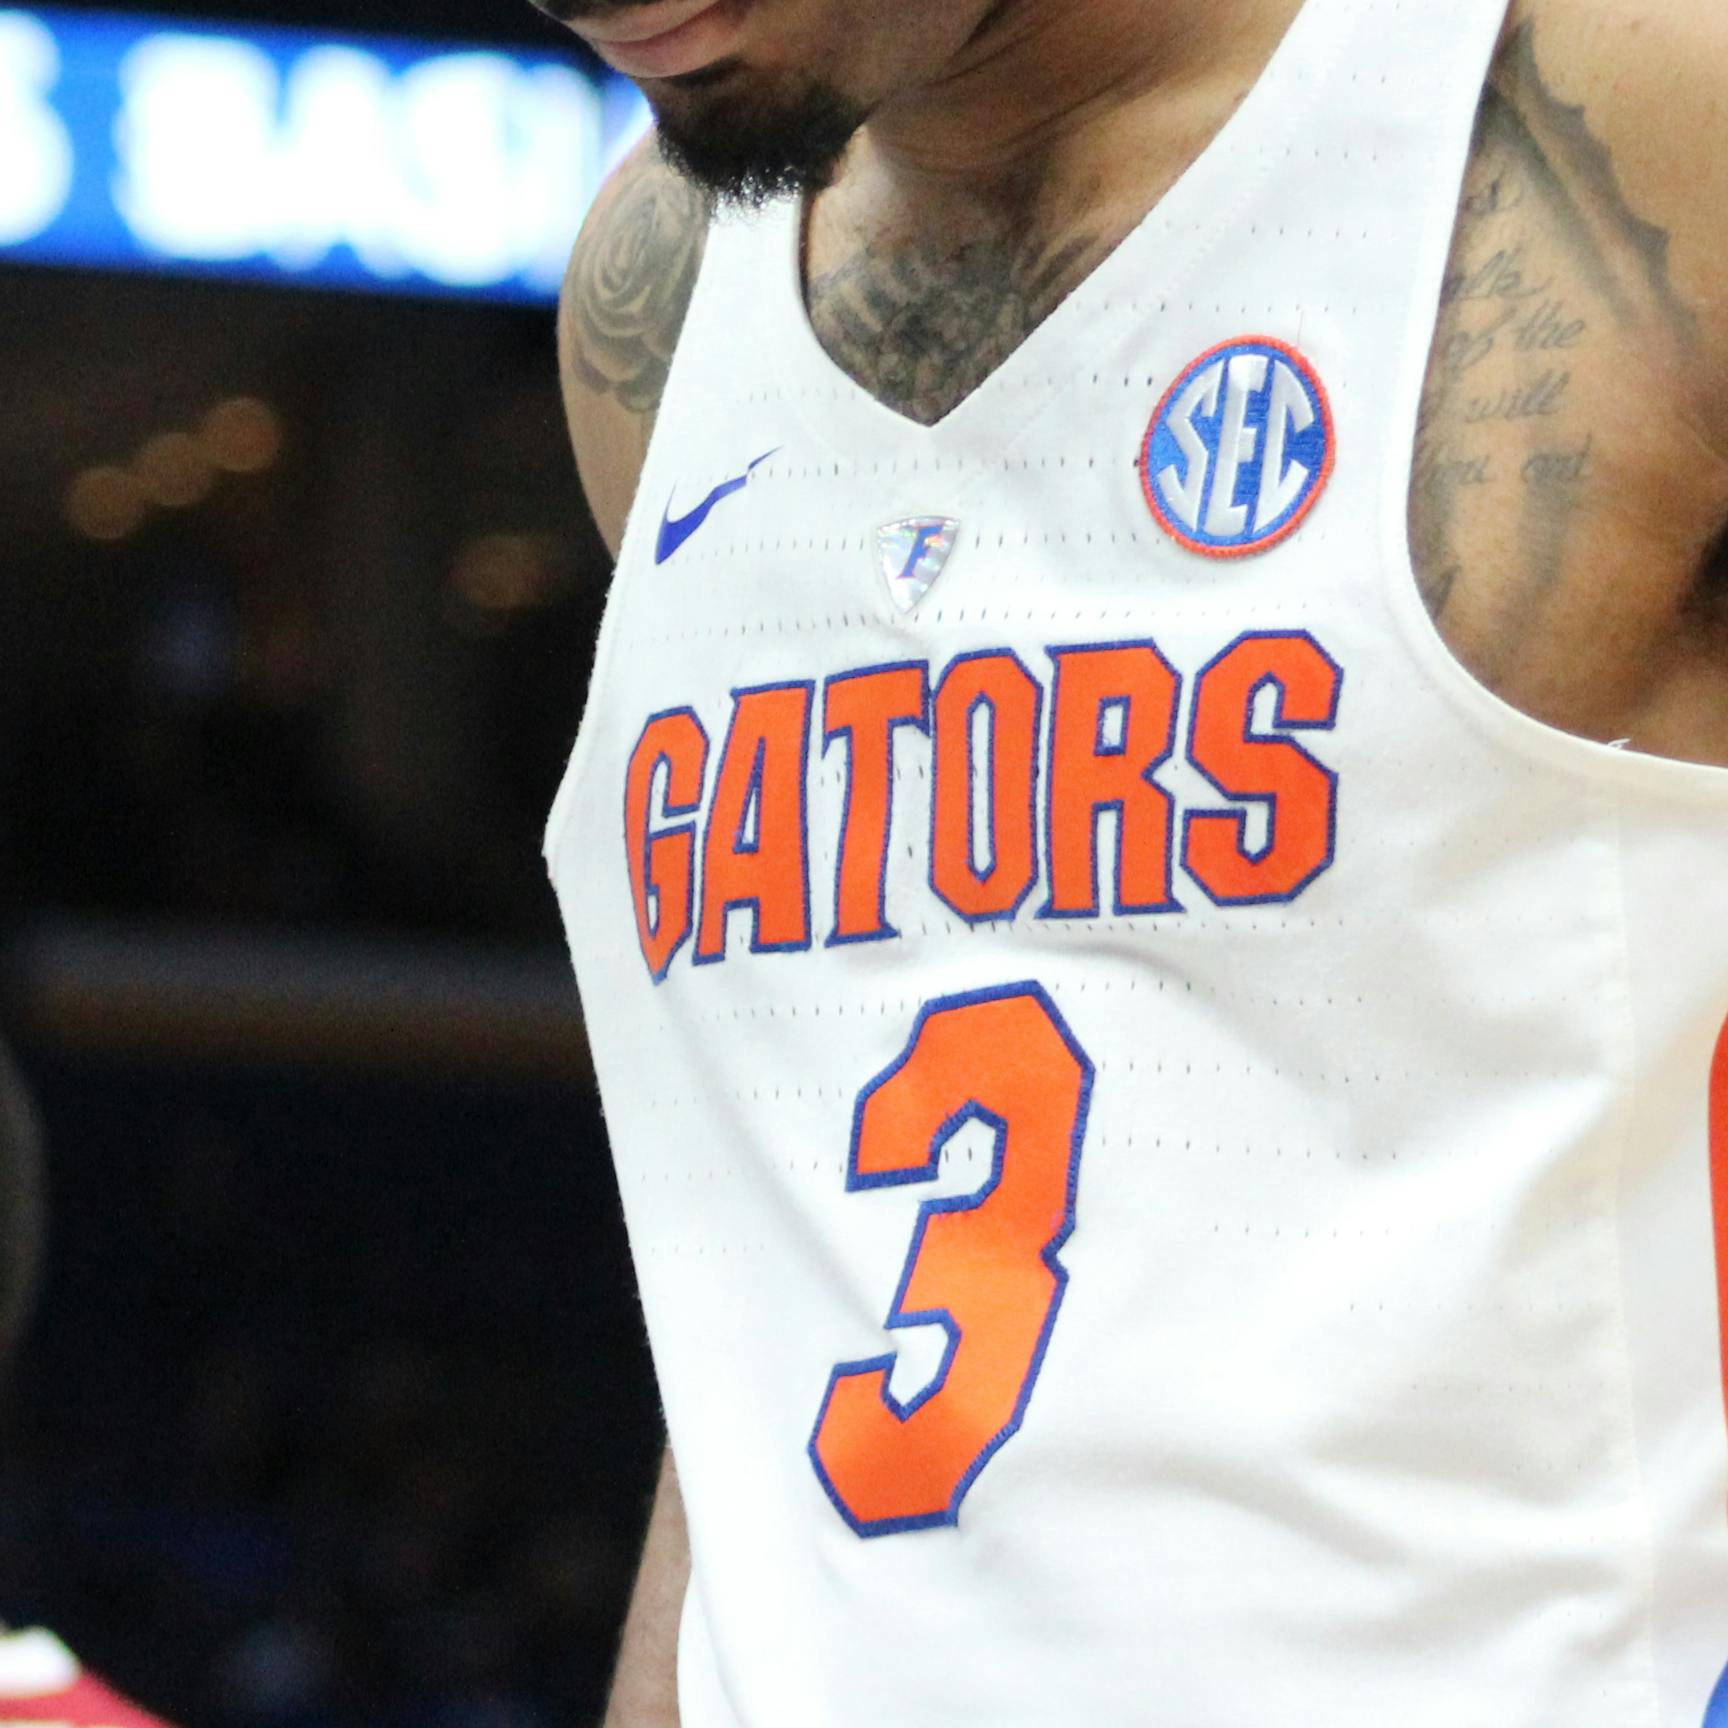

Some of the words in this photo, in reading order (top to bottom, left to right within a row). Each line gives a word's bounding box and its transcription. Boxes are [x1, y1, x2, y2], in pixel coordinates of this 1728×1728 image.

[1156, 353, 1316, 537] SEC
[624, 630, 1345, 986] GATORS
[807, 978, 1096, 1540] 3
